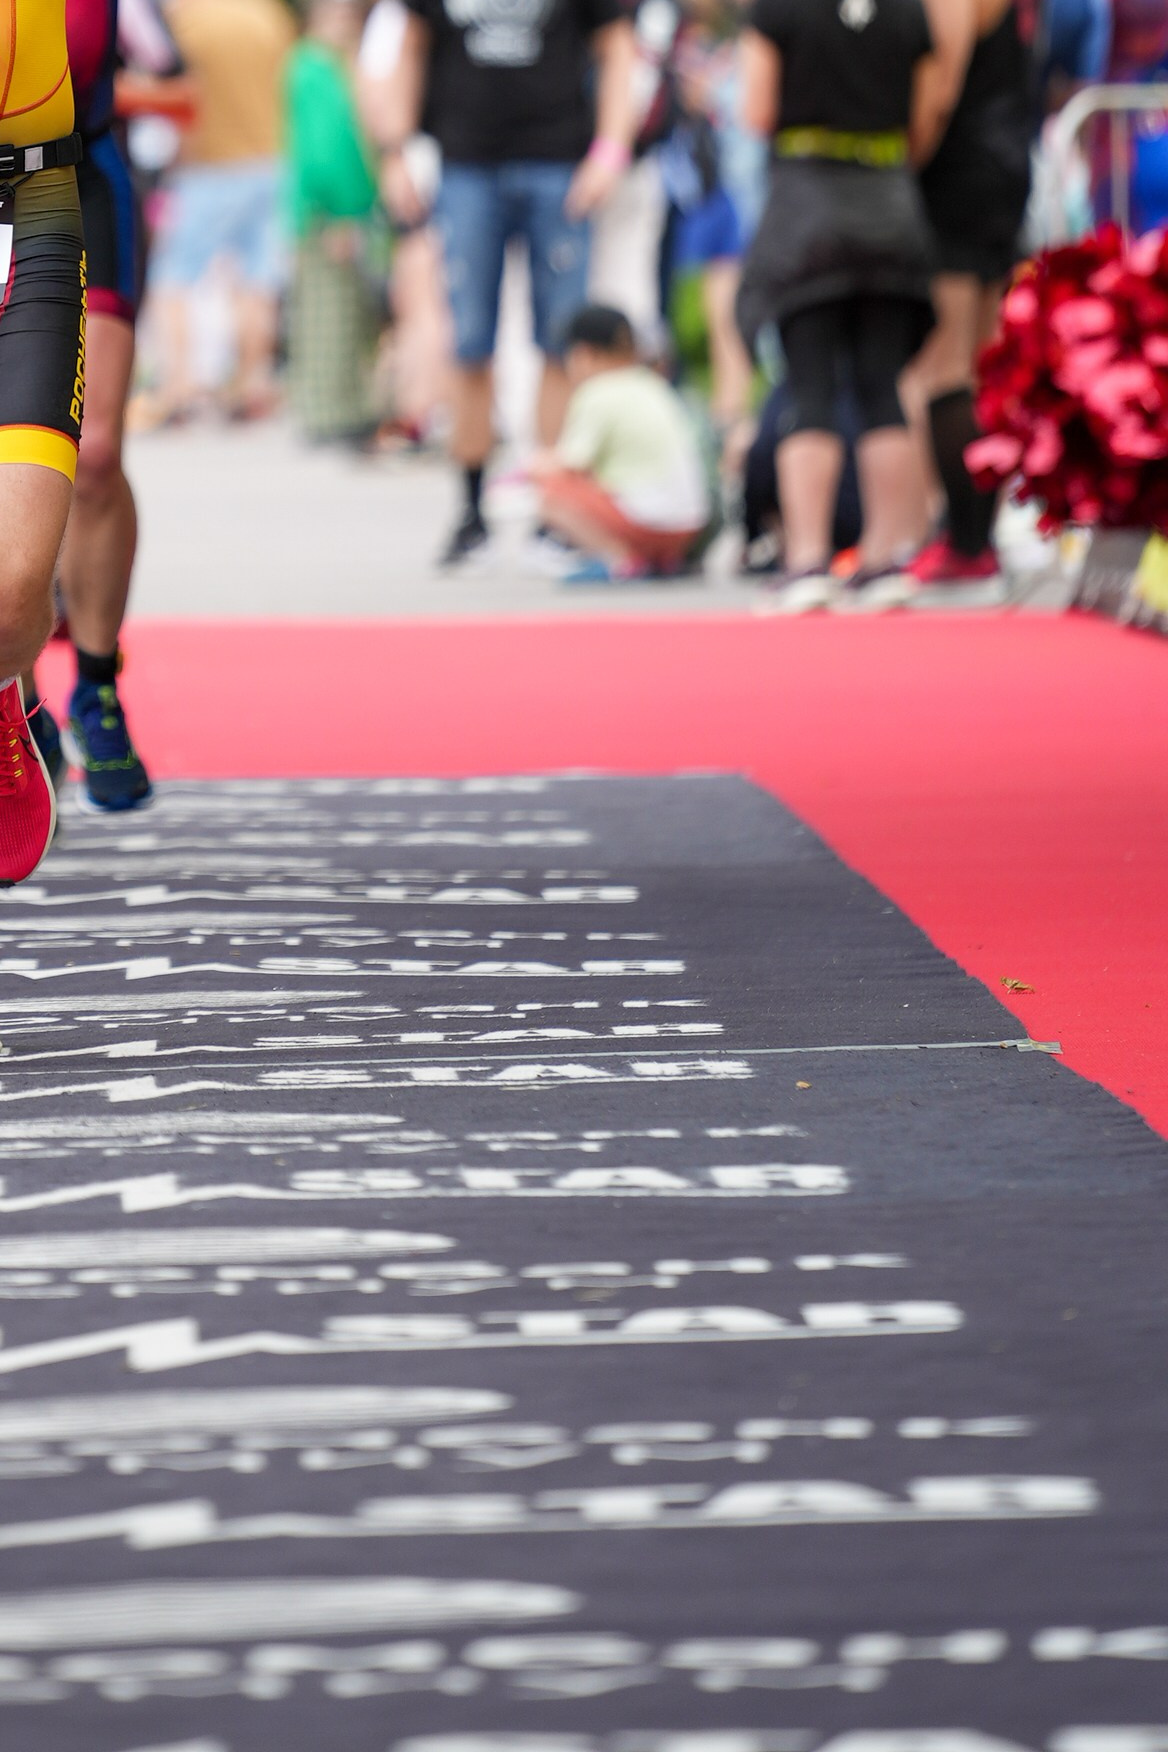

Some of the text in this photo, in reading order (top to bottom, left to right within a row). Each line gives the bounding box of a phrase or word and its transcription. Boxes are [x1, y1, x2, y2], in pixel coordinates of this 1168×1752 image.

[257, 956, 689, 973] STAR
[254, 1022, 727, 1047] STAR
[257, 1059, 756, 1085] STAR
[293, 1163, 850, 1193] STAR
[320, 1299, 965, 1342] STAR
[353, 1473, 1102, 1528] STAR
